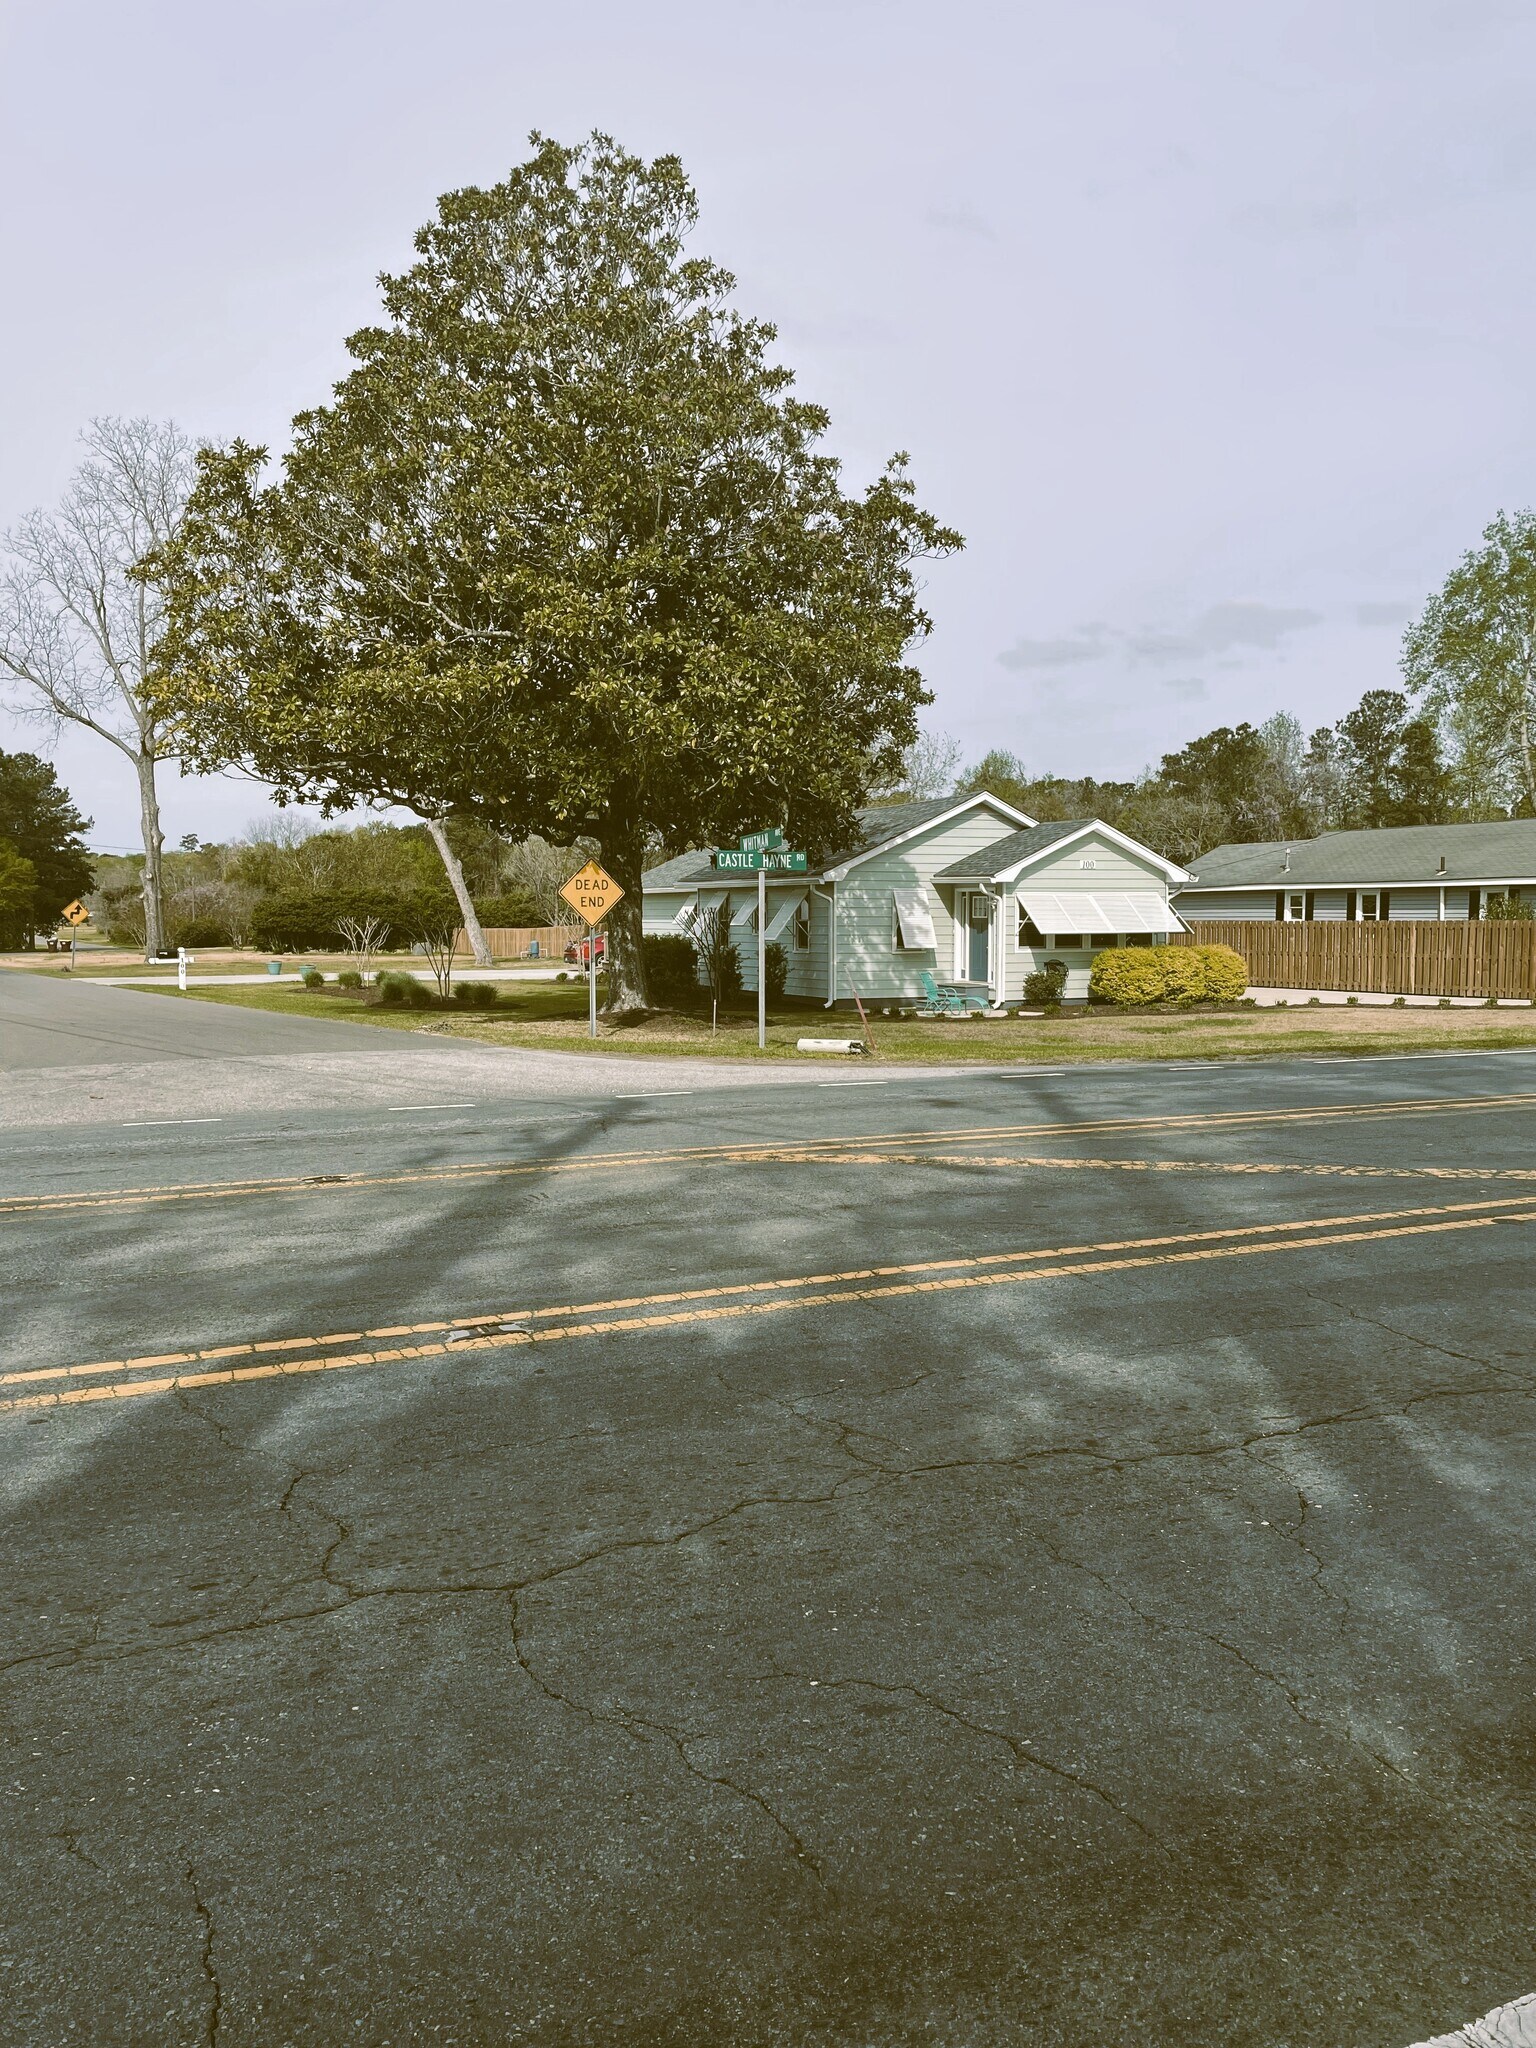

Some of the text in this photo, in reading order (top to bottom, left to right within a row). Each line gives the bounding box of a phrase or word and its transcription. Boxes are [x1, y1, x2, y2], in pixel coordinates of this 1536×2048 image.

[742, 833, 769, 852] WHITMAN
[718, 853, 754, 868] CASTLE
[762, 854, 792, 868] HAYNE
[575, 879, 609, 890] DEAD
[580, 896, 605, 907] END
